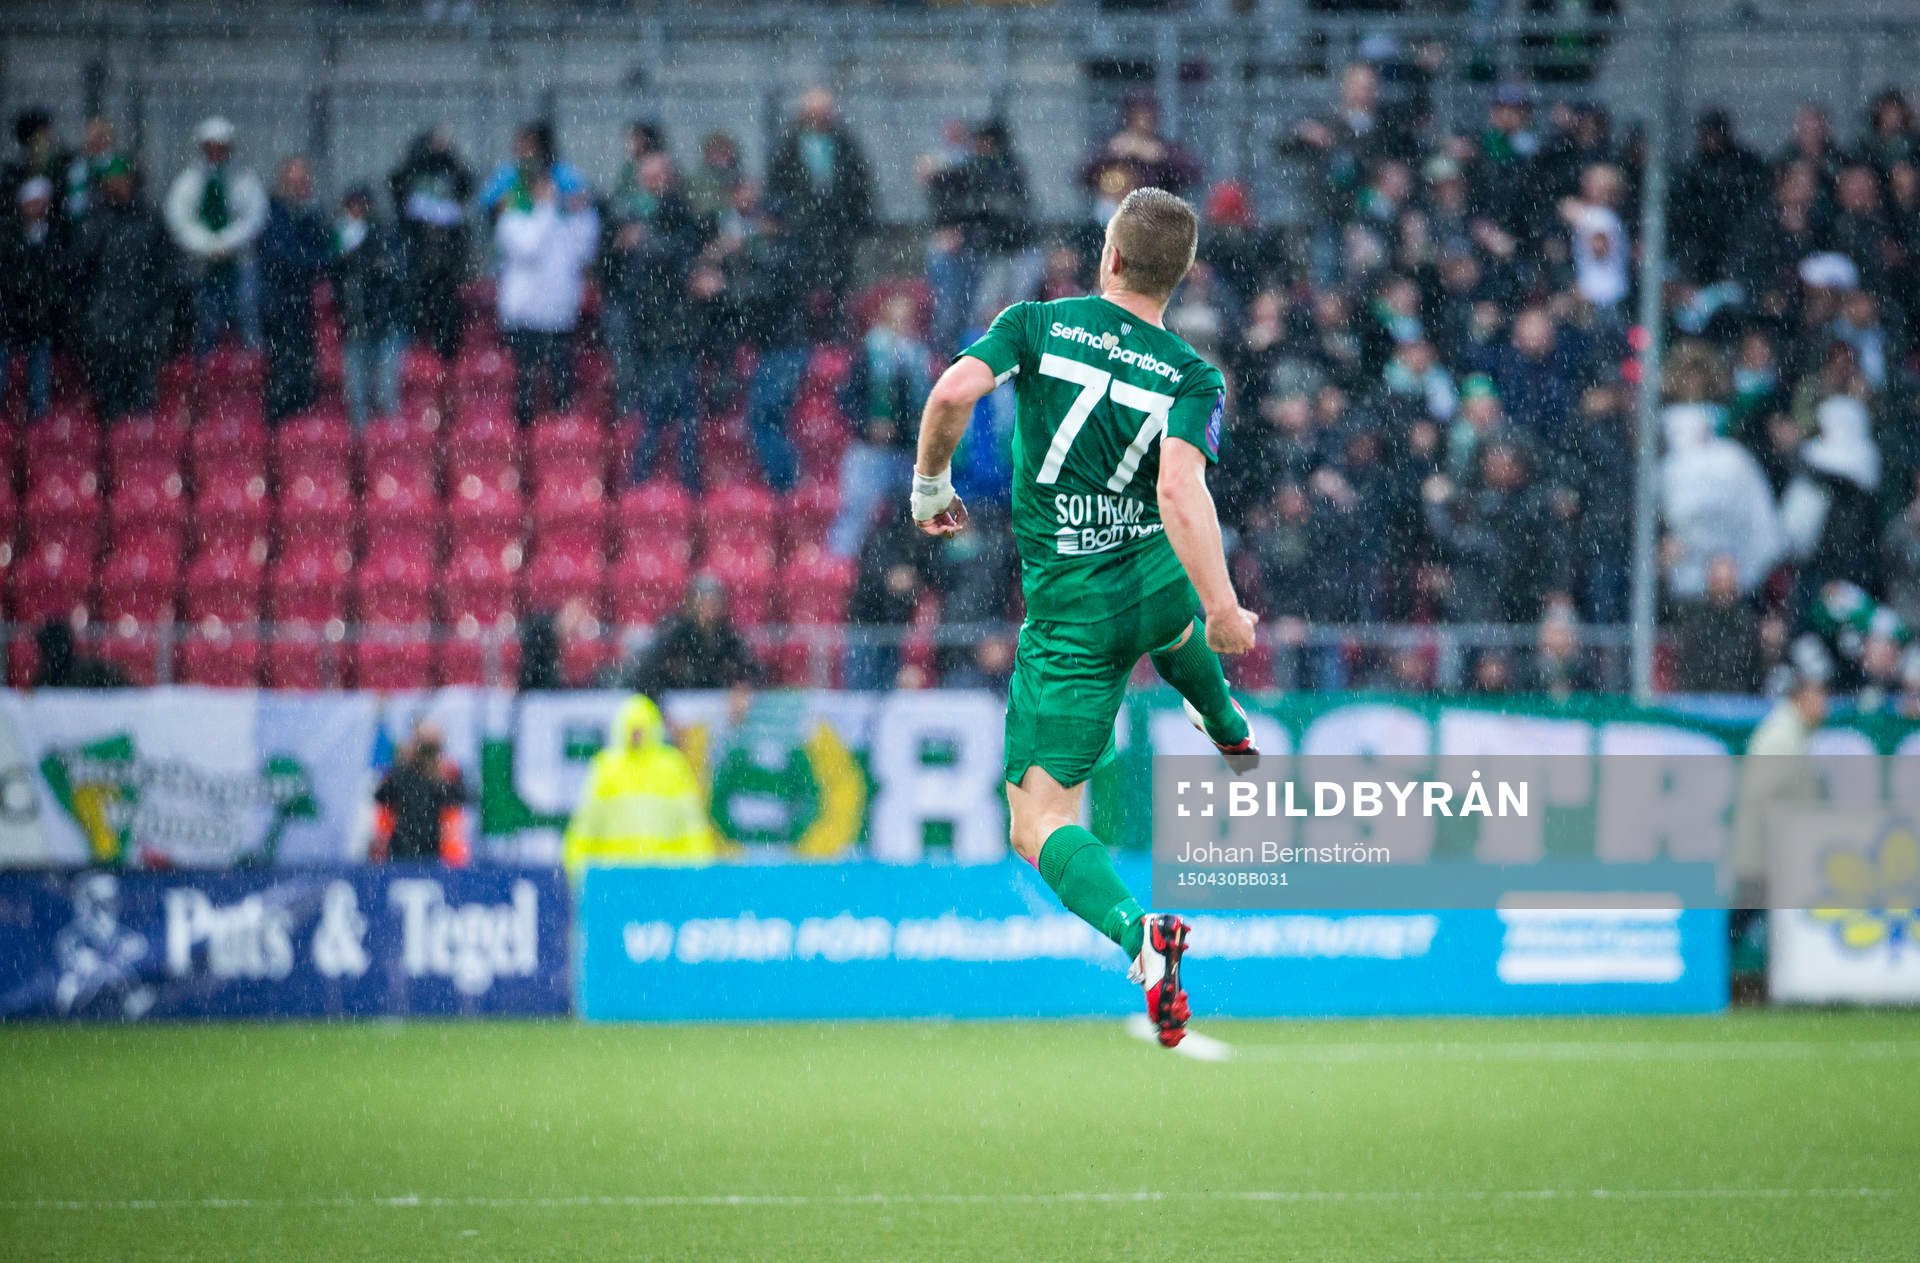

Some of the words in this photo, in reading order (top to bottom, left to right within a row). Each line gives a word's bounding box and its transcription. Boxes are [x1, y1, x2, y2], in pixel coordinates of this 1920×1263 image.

[1050, 321, 1104, 350] Sefina
[1108, 345, 1184, 384] pantbank
[1035, 352, 1176, 494] 77
